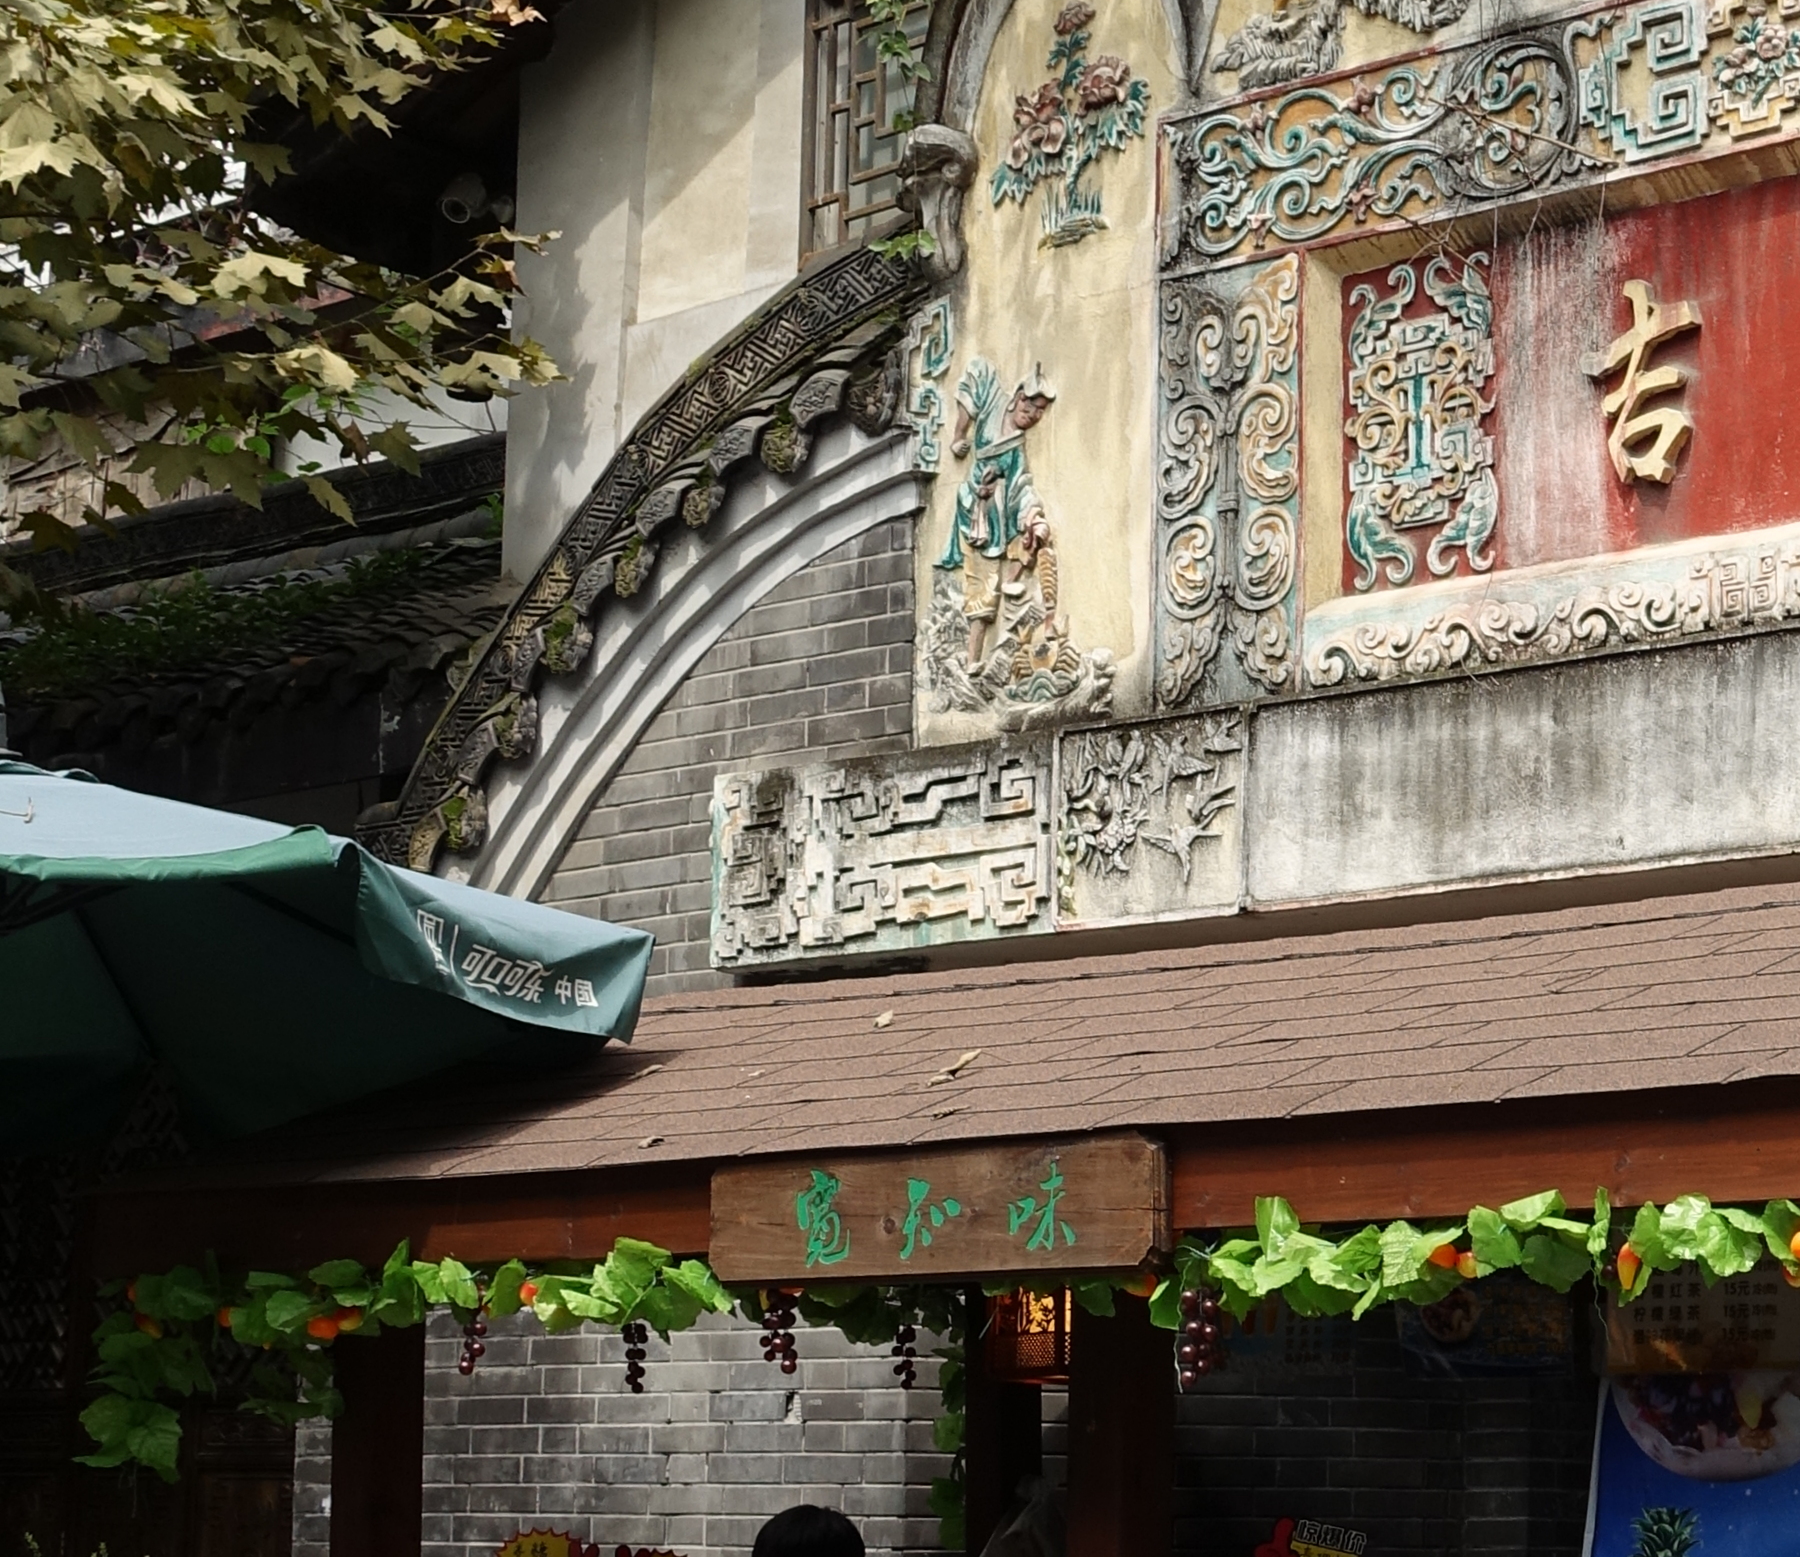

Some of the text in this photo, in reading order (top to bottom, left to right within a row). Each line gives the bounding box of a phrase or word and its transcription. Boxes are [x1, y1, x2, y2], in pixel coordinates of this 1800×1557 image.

[461, 943, 599, 1007] 可口可乐 中国
